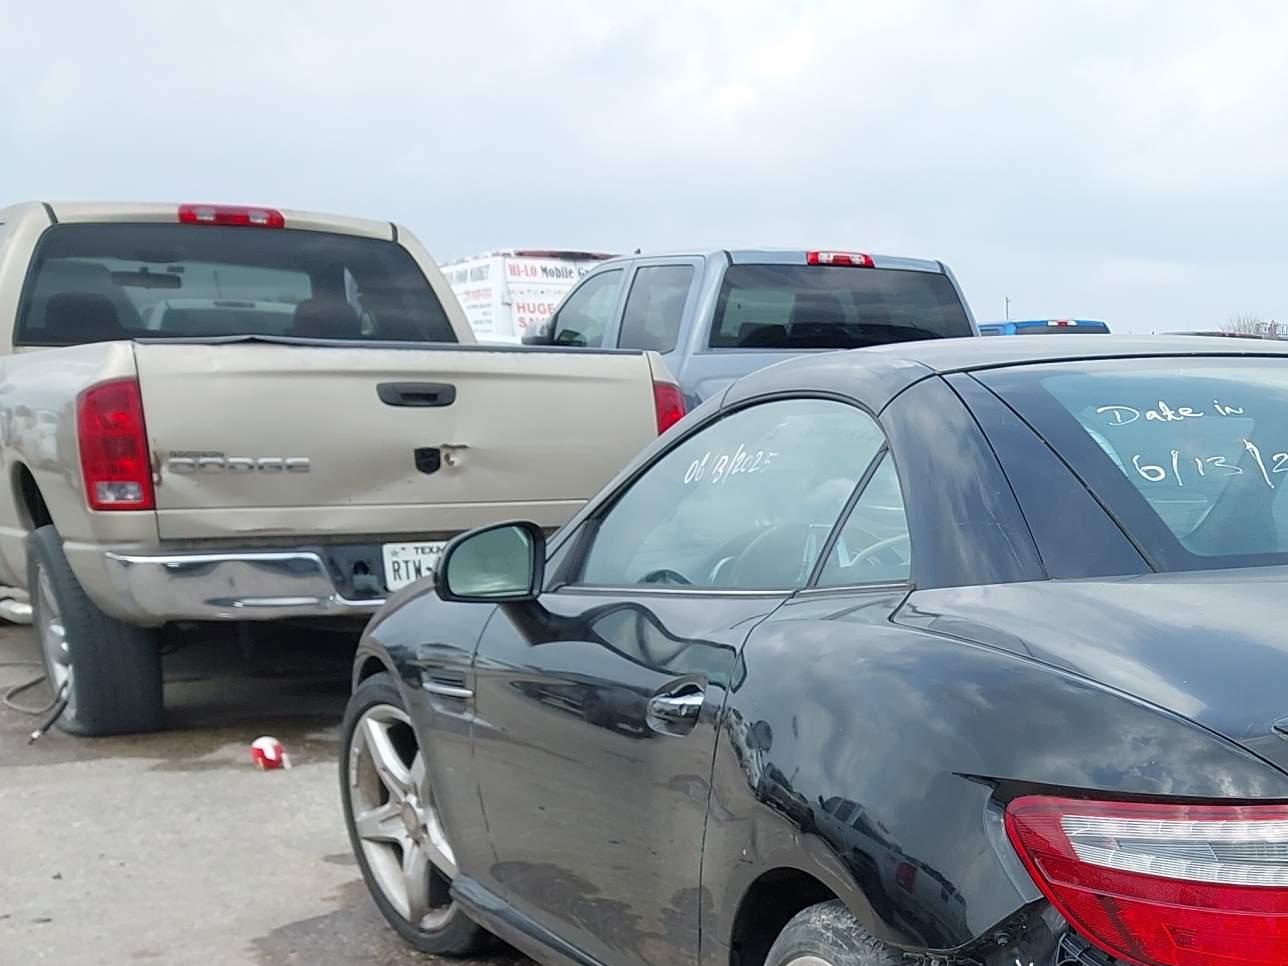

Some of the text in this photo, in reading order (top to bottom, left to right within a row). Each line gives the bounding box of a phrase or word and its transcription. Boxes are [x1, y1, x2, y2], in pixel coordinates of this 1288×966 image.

[508, 263, 537, 278] HI-LO
[541, 264, 574, 279] Mobile
[516, 302, 554, 315] HUGE
[1097, 400, 1244, 426] Date in
[413, 545, 444, 555] TEXA
